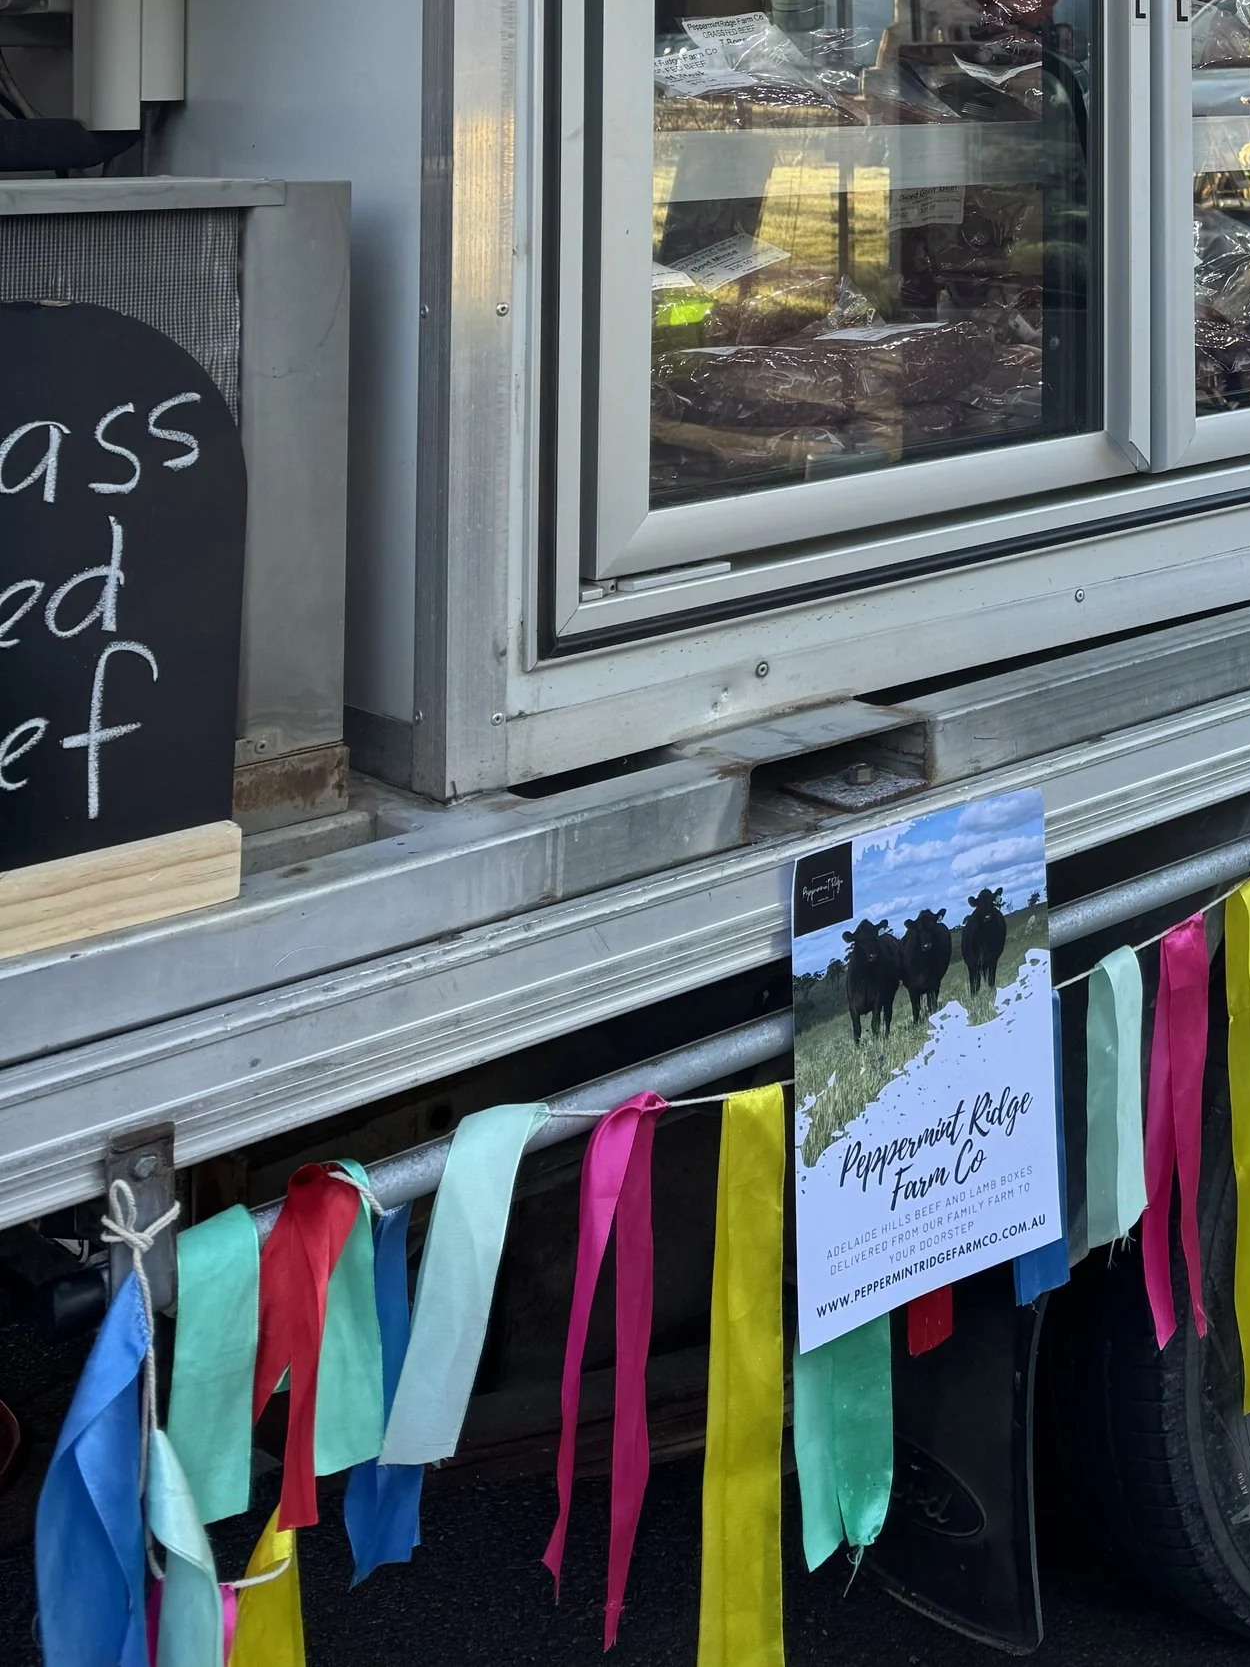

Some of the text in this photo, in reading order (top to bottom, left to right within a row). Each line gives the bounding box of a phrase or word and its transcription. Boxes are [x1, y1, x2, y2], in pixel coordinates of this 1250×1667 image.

[839, 1086, 1034, 1193] Peppermint Ridge
[890, 1138, 987, 1211] Farm Co
[826, 1165, 1033, 1260] ADELAIDE HILLS BEEF AND LAMB BOXES
[830, 1182, 1030, 1276] DELIVERED FROM OUR FAMILY FARM TO
[889, 1221, 974, 1265] YOUR DOORSTEP
[816, 1213, 1047, 1318] WWW.PEPPERMINTRIDGEFARMCO.COM.AU
